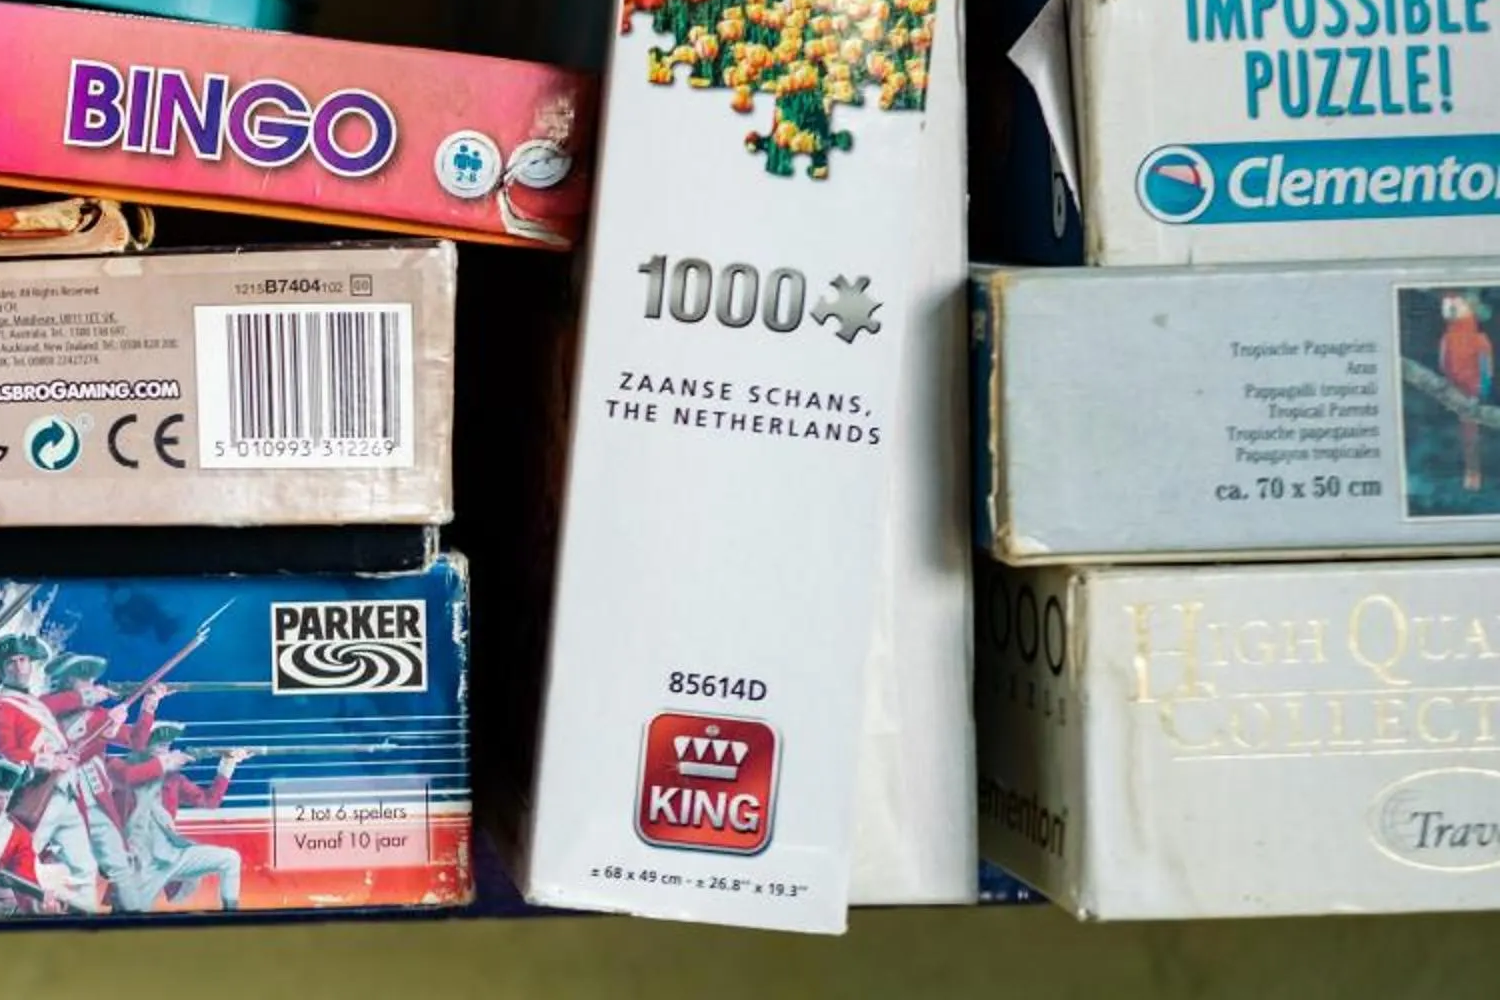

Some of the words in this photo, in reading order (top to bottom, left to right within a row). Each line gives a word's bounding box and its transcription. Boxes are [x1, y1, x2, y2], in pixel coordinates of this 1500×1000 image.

[1246, 45, 1454, 120] PUZZLE!
[64, 57, 397, 178] BINGO
[1228, 154, 1500, 208] Clemento
[638, 254, 806, 333] 1000
[619, 371, 733, 402] ZAANSE
[747, 385, 873, 418] SCHANS,
[1269, 403, 1326, 420] Tropical
[1329, 401, 1379, 417] Parrots
[605, 399, 658, 423] THE
[673, 406, 881, 446] NETHERLANDS
[215, 441, 225, 457] 5
[237, 440, 313, 457] 010993
[322, 439, 396, 458] 312269
[1215, 484, 1249, 501] ca.
[1256, 476, 1284, 499] 70
[1291, 482, 1306, 498] x
[1312, 475, 1341, 498] 50
[1348, 480, 1382, 497] cm
[275, 604, 422, 641] PARKER
[1122, 601, 1330, 702] HIGH
[1348, 593, 1500, 685] QUA
[668, 671, 767, 701] 85614D
[294, 804, 306, 822] 2
[311, 805, 331, 822] tot
[336, 803, 347, 821] 6
[352, 801, 407, 828] spelers
[648, 785, 761, 834] KING
[294, 831, 344, 850] Vanaf
[350, 831, 371, 849] 10
[374, 833, 408, 852] jaar
[1410, 811, 1500, 848] Trav
[604, 865, 622, 880] 68
[626, 872, 635, 881] x
[639, 868, 657, 883] 49
[661, 873, 682, 885] cm
[754, 884, 763, 894] x
